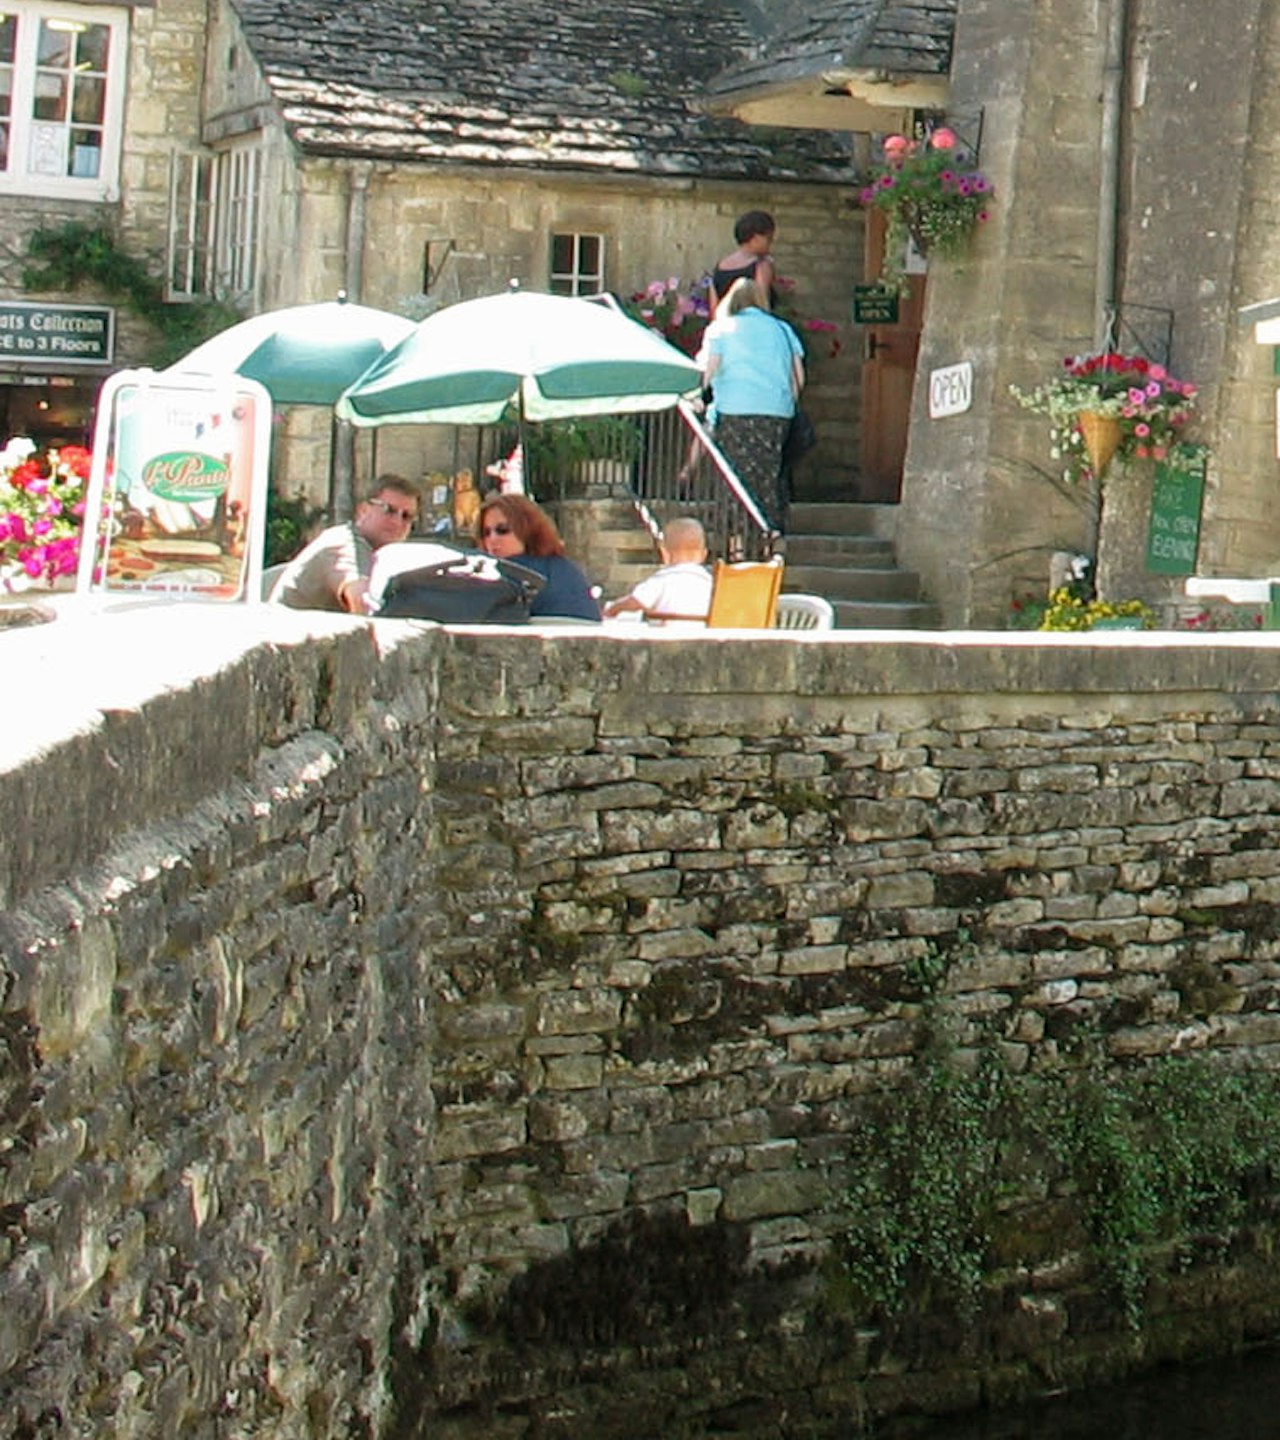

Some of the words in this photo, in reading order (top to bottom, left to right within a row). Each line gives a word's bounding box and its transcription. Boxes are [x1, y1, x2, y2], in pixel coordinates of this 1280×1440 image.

[18, 336, 35, 349] to
[37, 336, 47, 350] 3
[51, 336, 101, 352] Floors
[932, 368, 969, 409] OPEN
